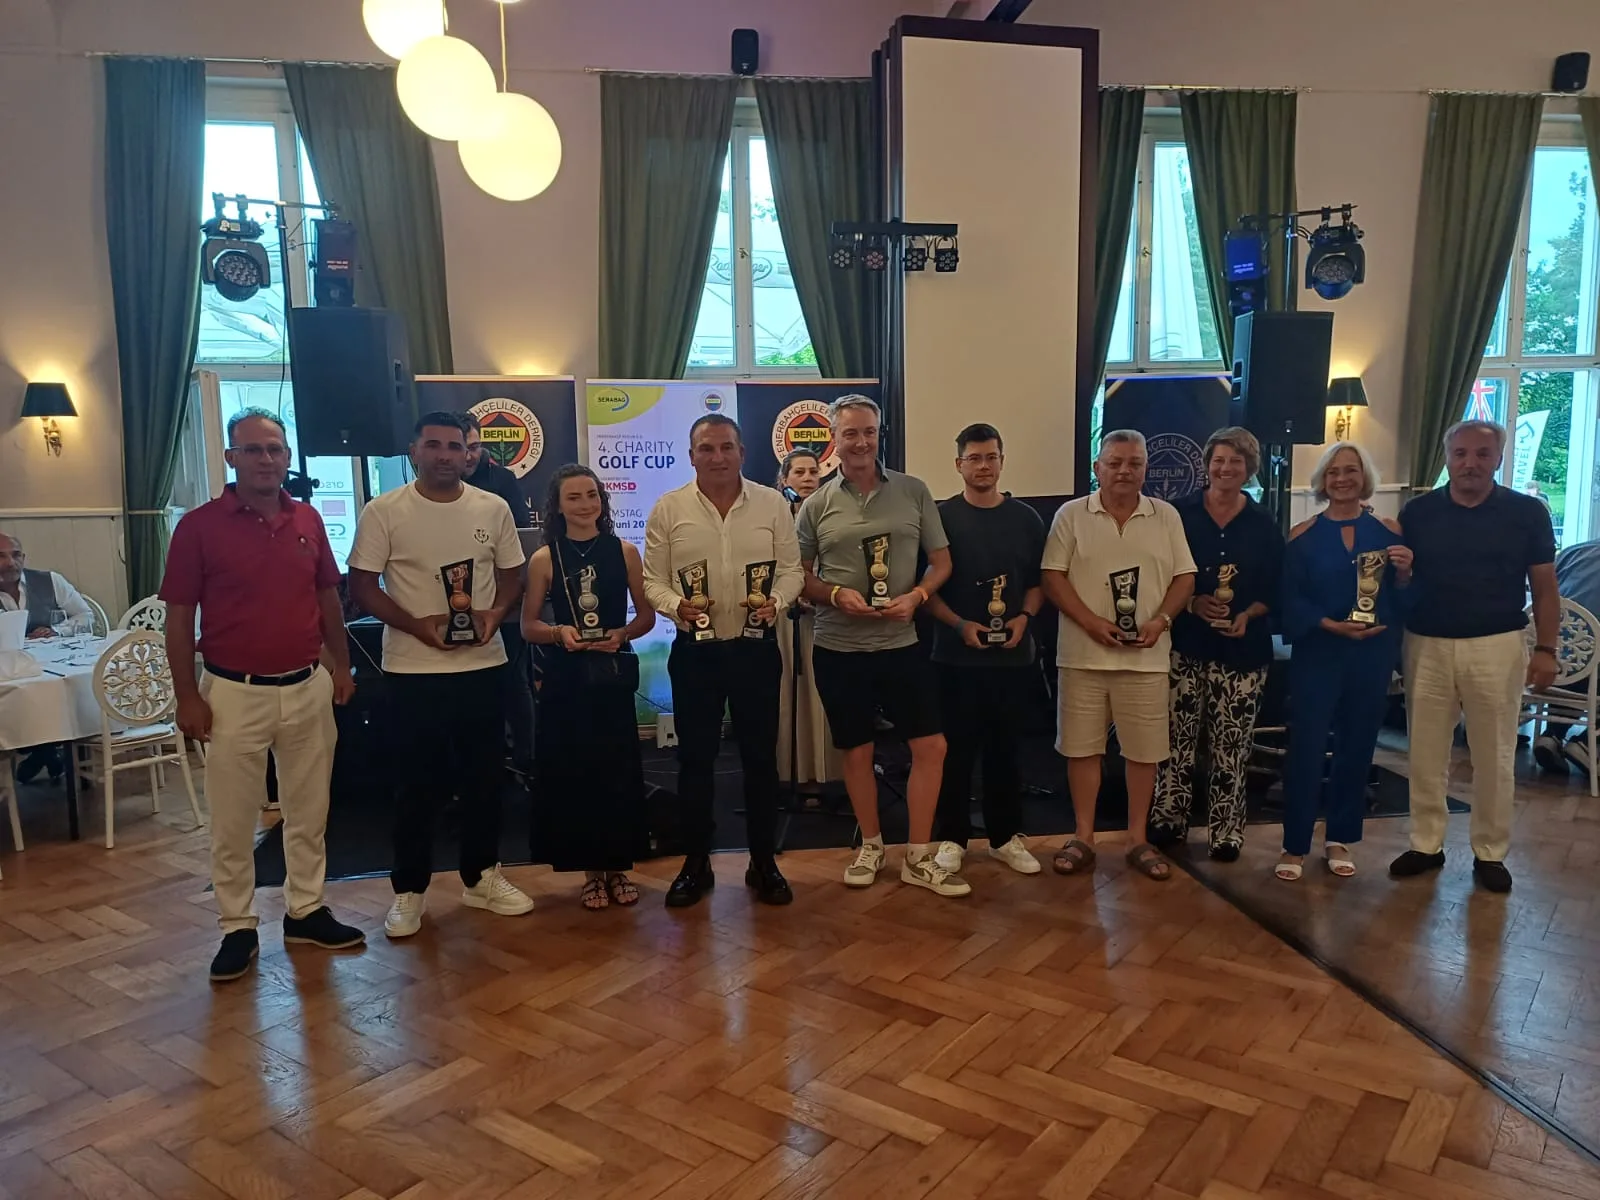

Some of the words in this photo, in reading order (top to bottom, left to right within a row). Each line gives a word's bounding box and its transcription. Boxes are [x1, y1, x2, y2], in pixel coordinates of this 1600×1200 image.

[483, 428, 520, 438] BERLİN
[793, 430, 827, 439] BERLİN
[598, 442, 611, 453] 4.
[615, 441, 674, 453] CHARITY
[599, 456, 640, 469] GOLF
[644, 456, 675, 469] CUP
[612, 508, 643, 517] MSTAG
